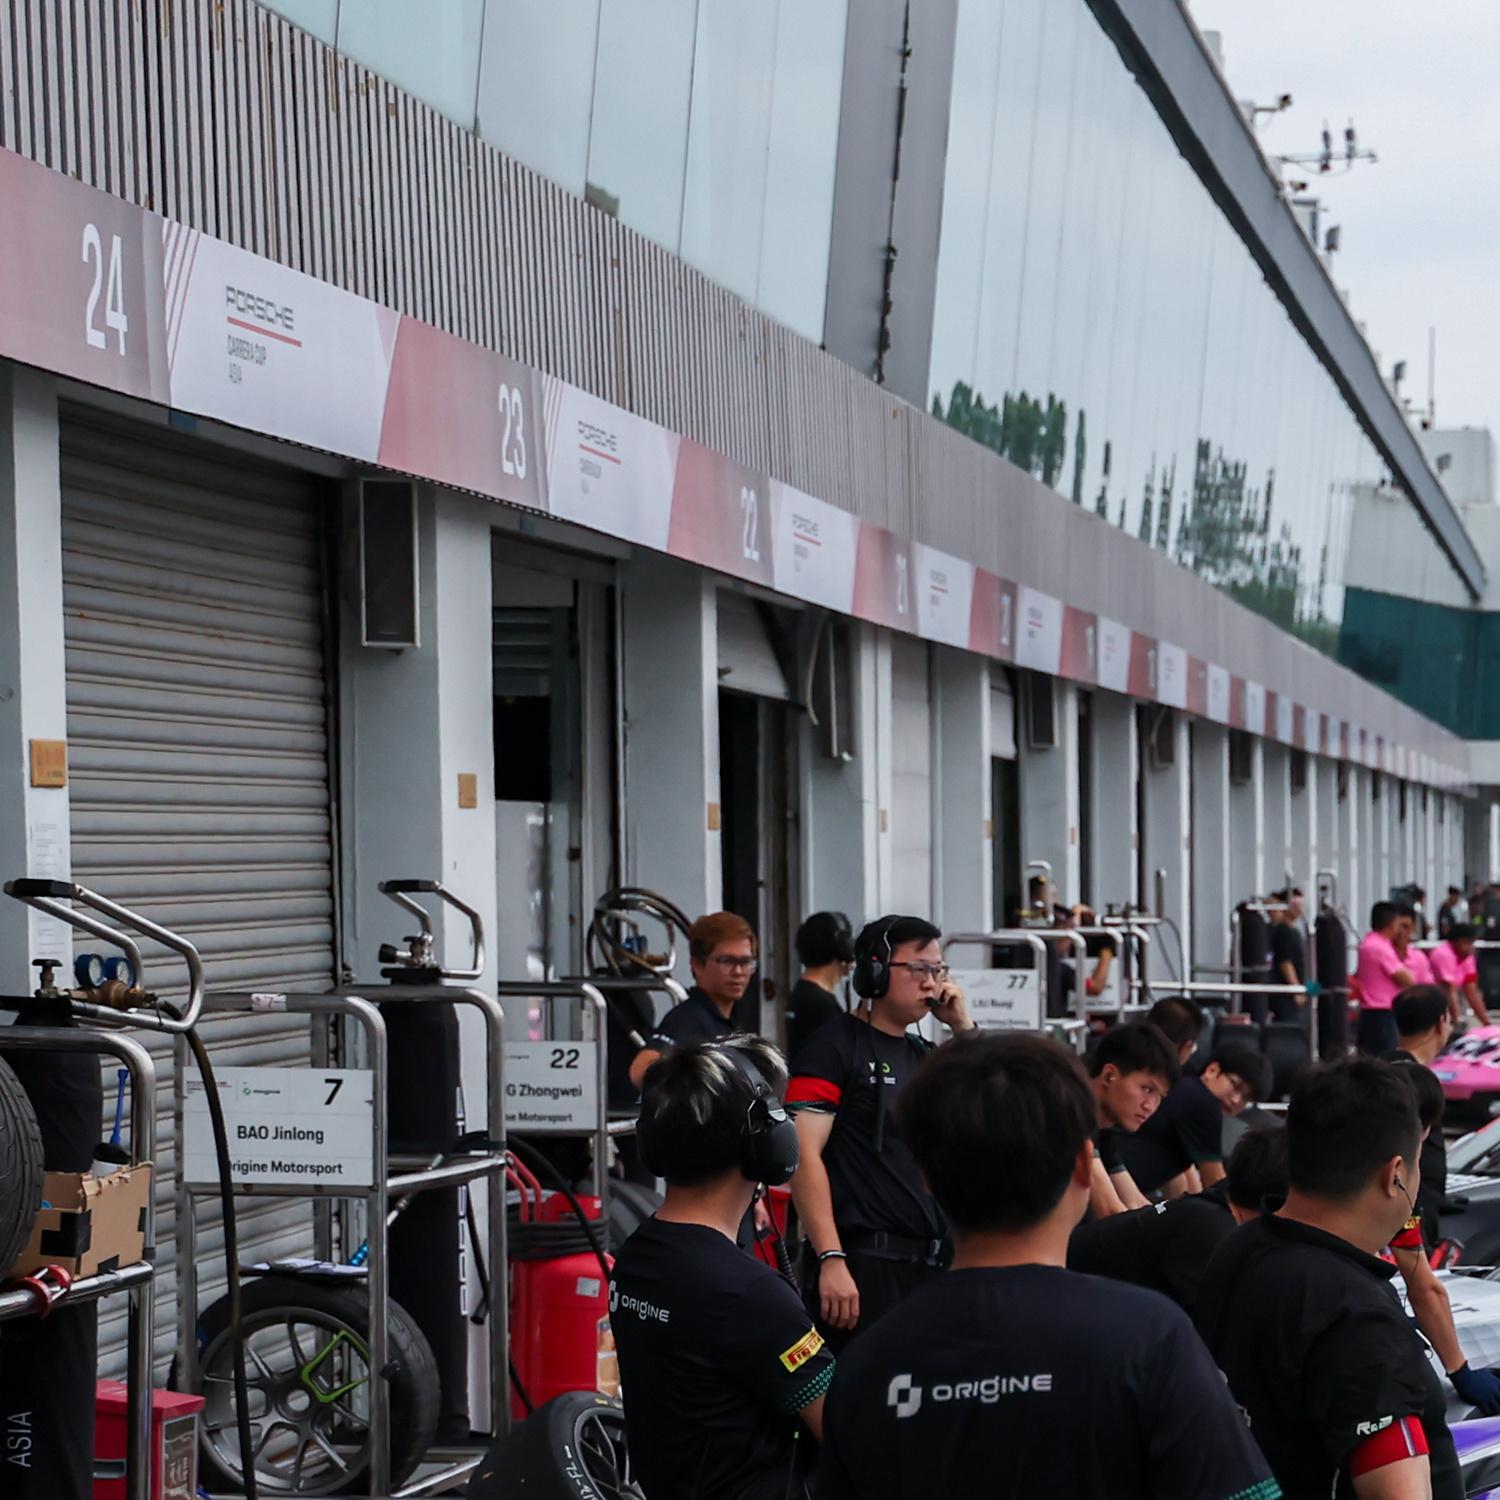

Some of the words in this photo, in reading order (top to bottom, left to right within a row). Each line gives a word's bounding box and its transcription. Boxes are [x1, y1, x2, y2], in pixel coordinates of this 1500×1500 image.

[82, 223, 128, 356] 24
[226, 285, 294, 331] PORSCHE
[500, 383, 527, 480] 23
[740, 486, 760, 562] 22
[1007, 973, 1027, 989] 77
[550, 1048, 580, 1069] 22
[323, 1078, 344, 1106] 7
[519, 1084, 582, 1099] Zhongwei
[518, 1112, 573, 1123] Motorsport
[237, 1125, 269, 1140] BAO
[272, 1126, 324, 1144] Jinlong
[228, 1161, 268, 1175] rigine
[271, 1161, 343, 1175] Motorsport
[7, 1411, 33, 1468] ASIA
